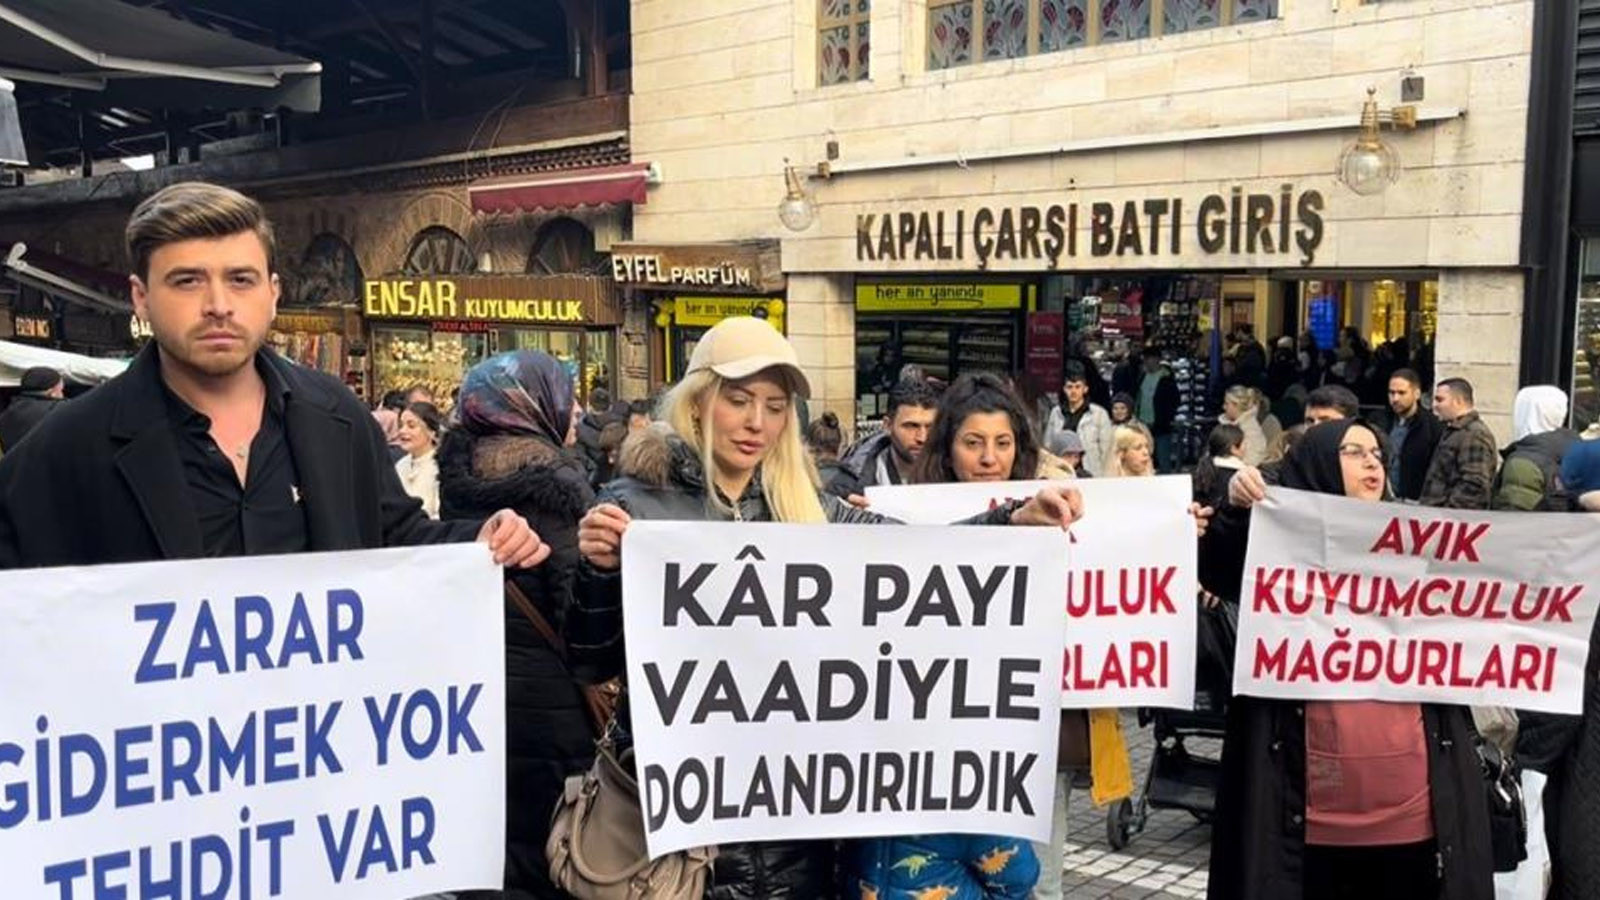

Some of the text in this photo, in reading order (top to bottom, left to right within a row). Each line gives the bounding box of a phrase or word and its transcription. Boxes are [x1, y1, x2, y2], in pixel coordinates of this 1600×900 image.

[856, 183, 1325, 269] KAPALI ÇARŞI BATI GİRİŞ
[364, 280, 582, 321] ENSAR KUYUMCULUK
[612, 254, 750, 286] EYFEL PARFÜM
[876, 283, 901, 299] her
[1370, 517, 1491, 563] AYIK
[662, 544, 1029, 628] KÂR PAYI
[1066, 566, 1177, 618] ULUK
[1252, 567, 1584, 623] KUYUMCULUK
[134, 588, 364, 684] ZARAR
[1252, 627, 1557, 693] MAĞDURLARI
[642, 641, 1042, 727] VAADİYLE
[0, 683, 485, 830] GİDERMEK YOK
[643, 749, 1039, 833] DOLANDIRILDIK
[317, 796, 436, 884] VAR
